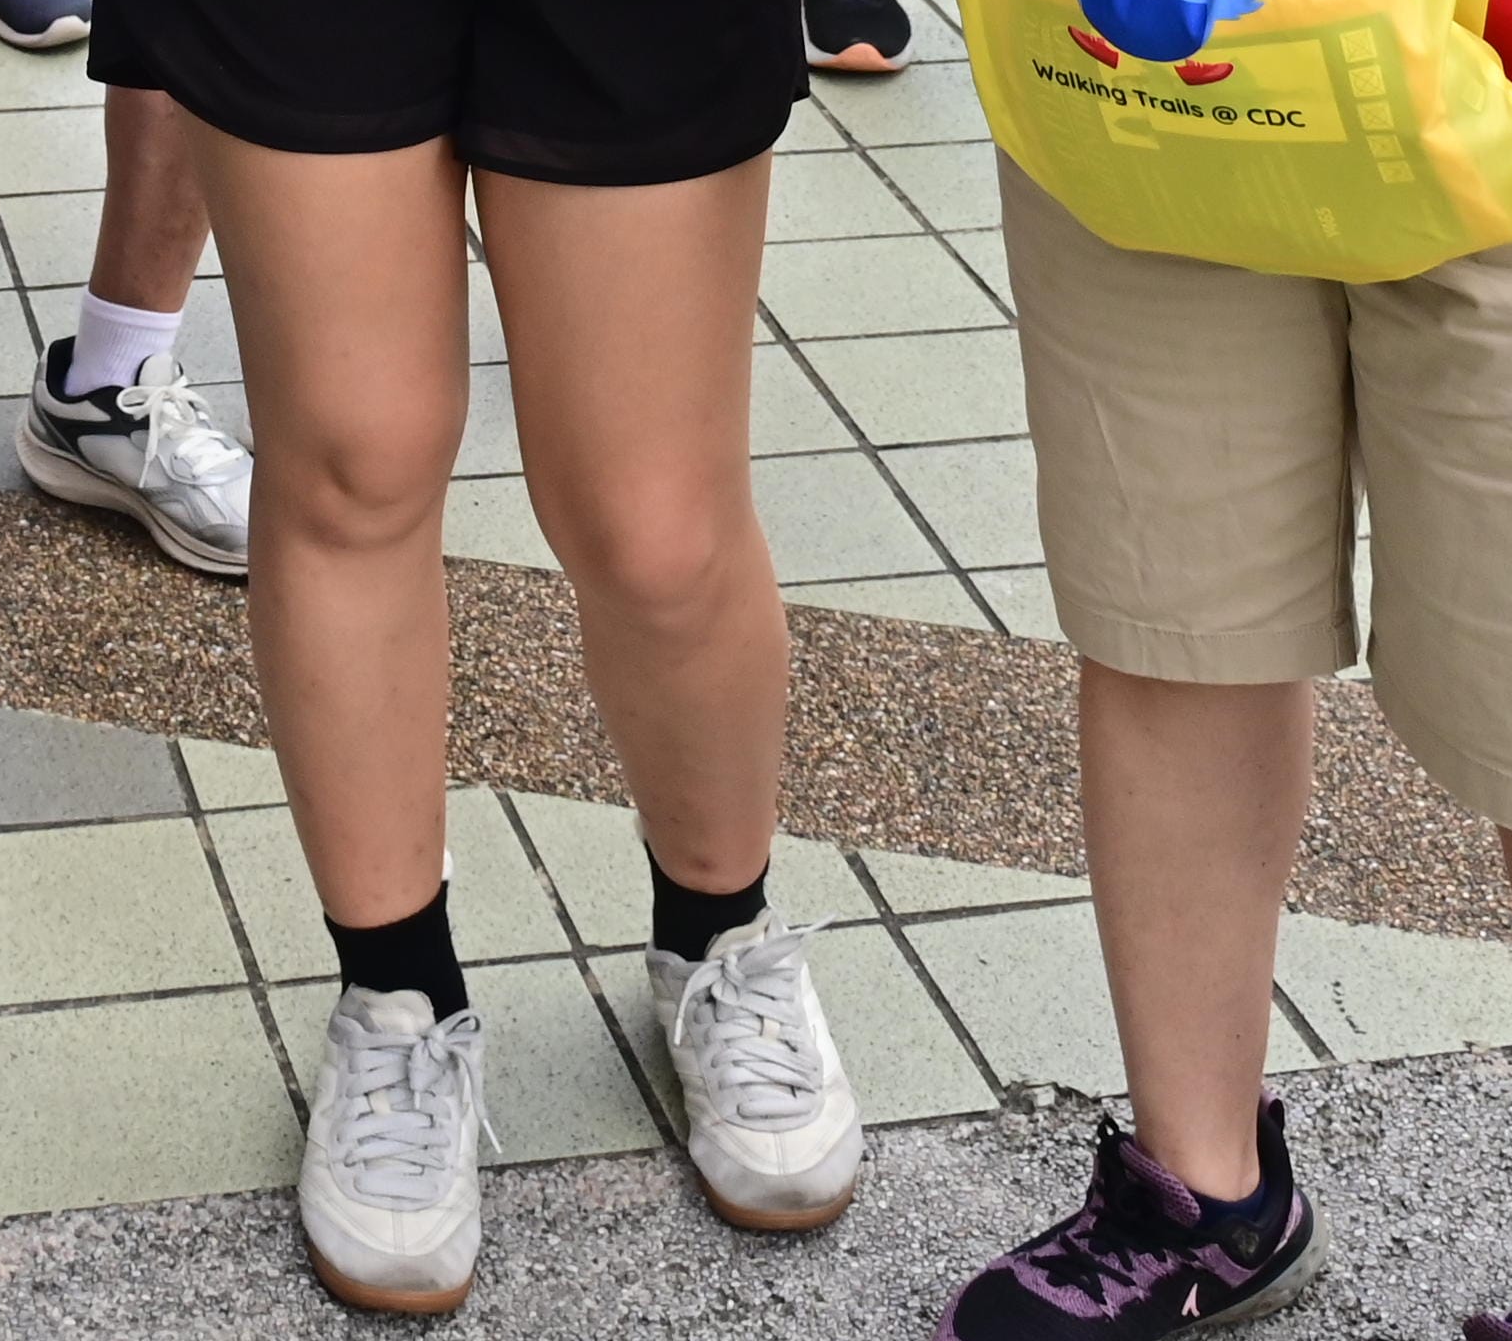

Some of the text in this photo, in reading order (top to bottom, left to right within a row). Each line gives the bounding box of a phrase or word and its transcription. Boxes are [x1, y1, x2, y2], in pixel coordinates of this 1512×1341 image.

[1032, 59, 1307, 128] Walking Trails @ CDC
